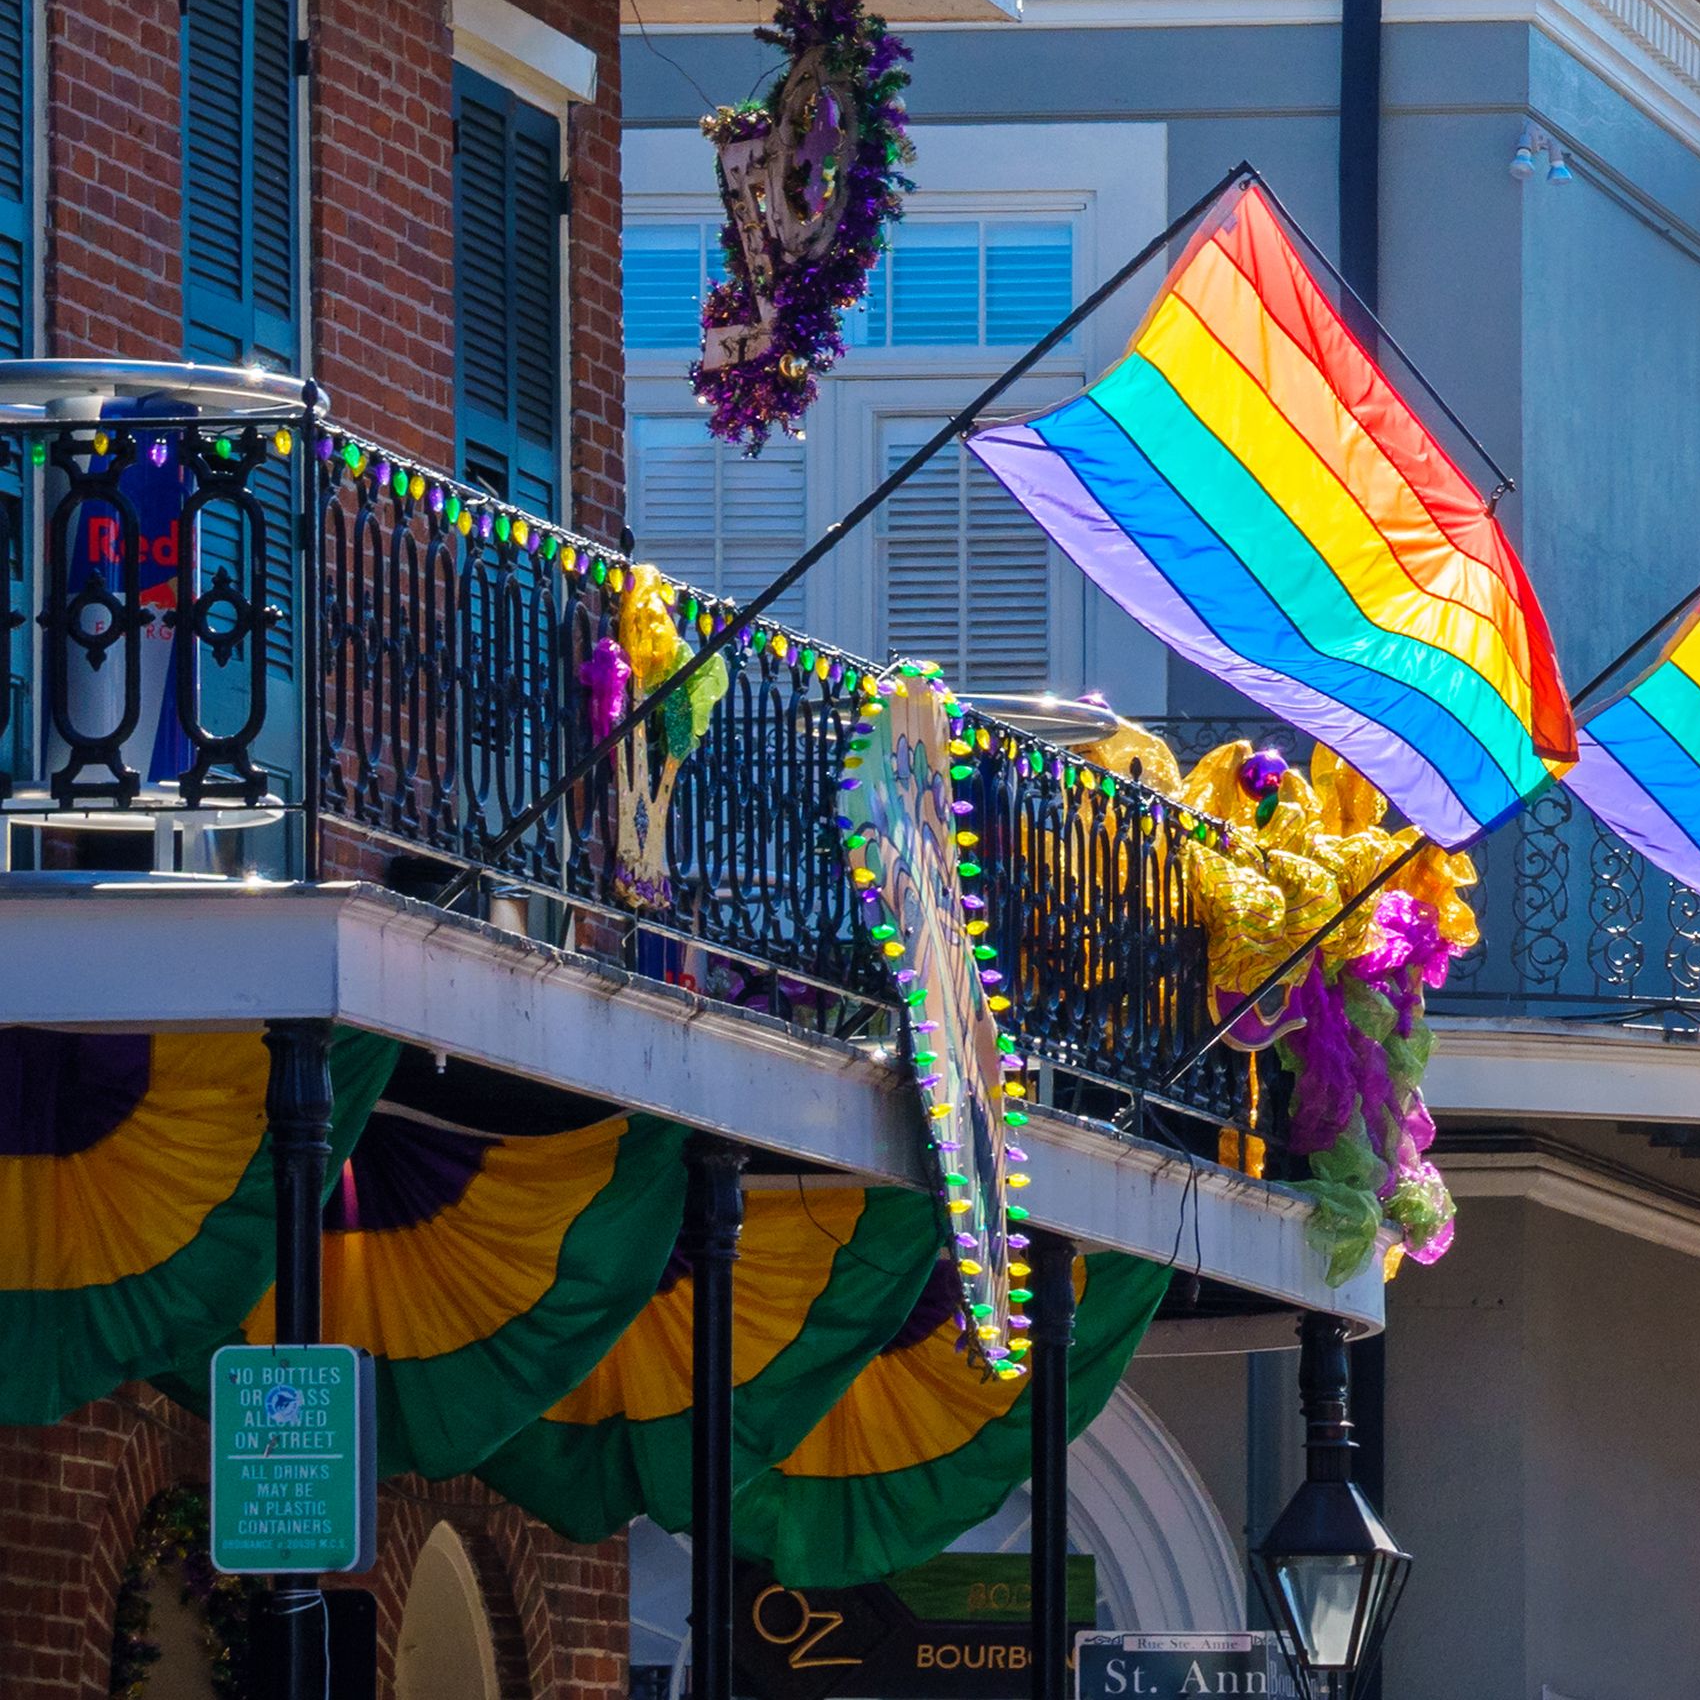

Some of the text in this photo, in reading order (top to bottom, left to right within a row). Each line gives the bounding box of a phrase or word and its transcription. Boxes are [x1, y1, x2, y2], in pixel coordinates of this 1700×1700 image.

[89, 517, 180, 566] Red
[229, 1366, 341, 1385] NO BOTTLES
[240, 1389, 263, 1406] OR
[244, 1410, 327, 1427] ALLWED
[235, 1431, 335, 1449] ON STREET
[241, 1464, 330, 1480] ALL DRINKS
[256, 1483, 313, 1498] MAY BE
[244, 1501, 327, 1516] IN PLASTIC
[238, 1519, 332, 1535] CONTAINERS
[753, 1584, 862, 1669] OZ
[1137, 1637, 1239, 1650] Rue Ste. Anne
[916, 1645, 1076, 1669] BOURBN
[1104, 1658, 1267, 1694] St. Ann
